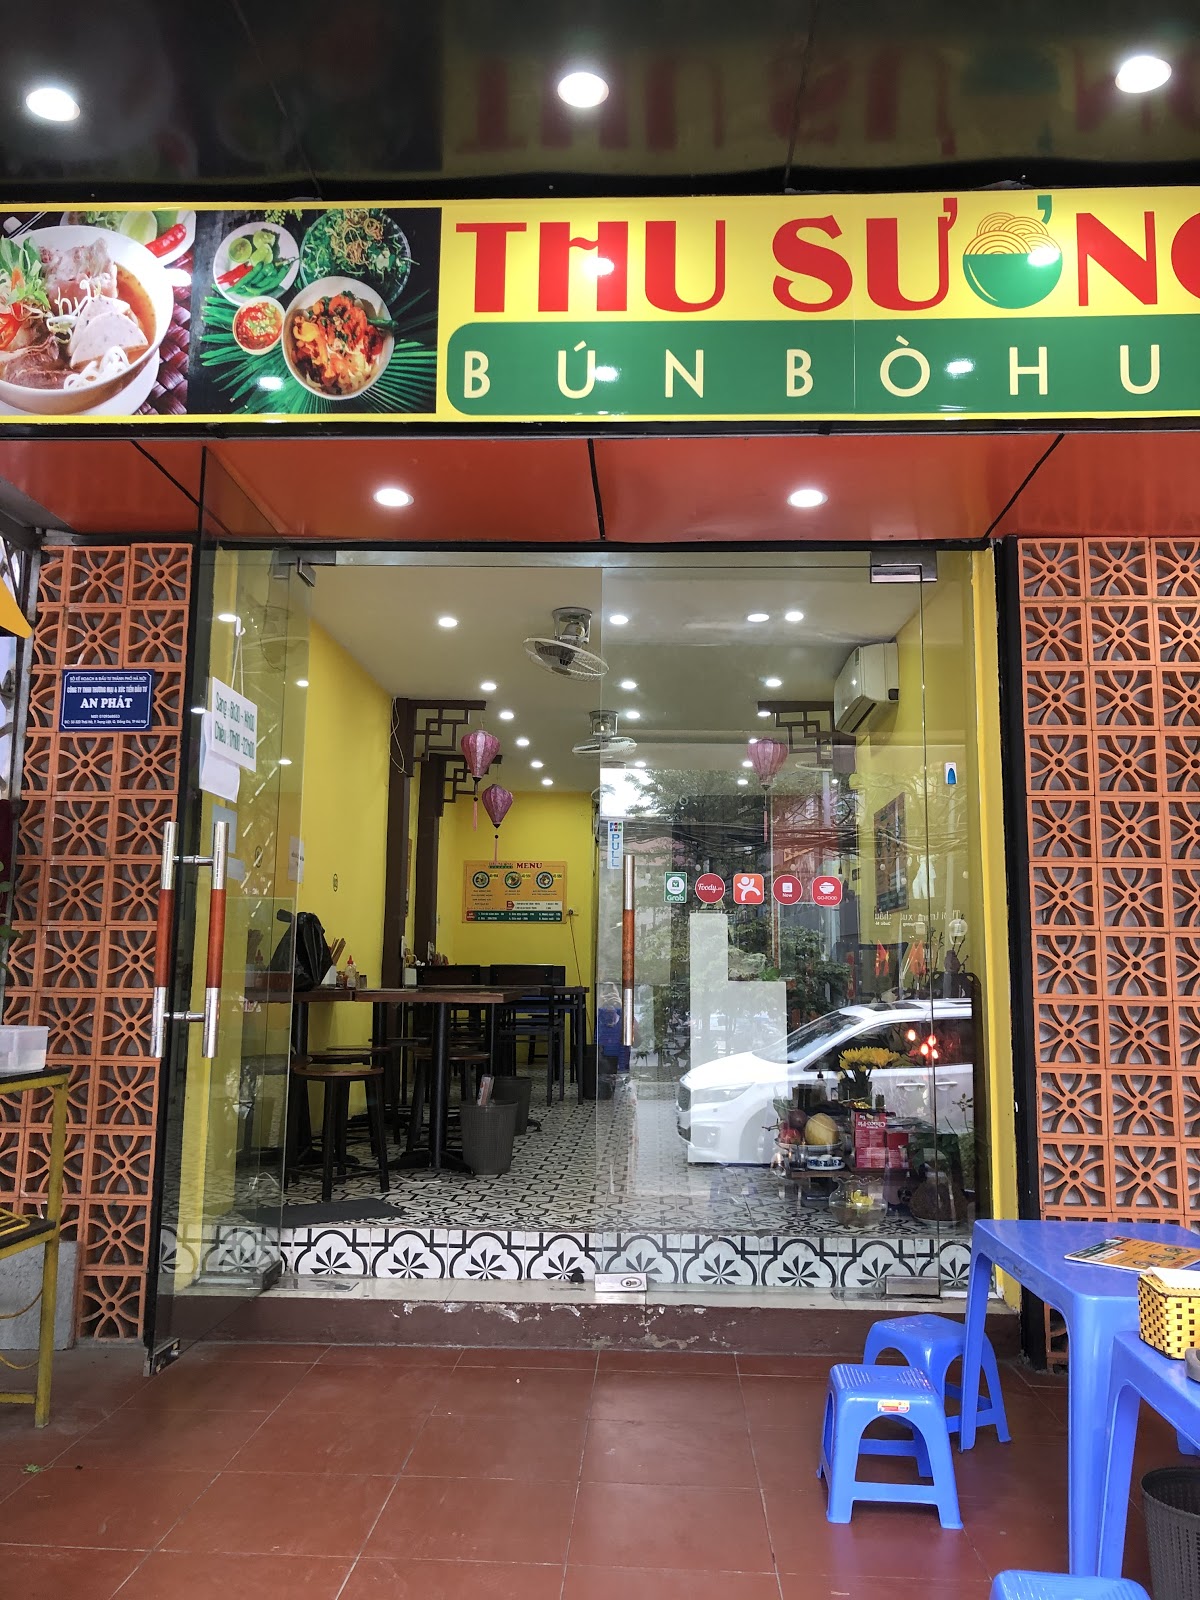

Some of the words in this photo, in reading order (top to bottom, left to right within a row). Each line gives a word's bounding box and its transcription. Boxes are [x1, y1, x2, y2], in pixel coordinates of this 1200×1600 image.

[456, 219, 726, 313] THU
[463, 340, 704, 399] BÚN
[786, 335, 931, 398] BÒ
[80, 698, 98, 708] AN
[100, 695, 133, 708] PHÁT
[612, 834, 620, 867] PULL
[666, 894, 684, 902] Grab
